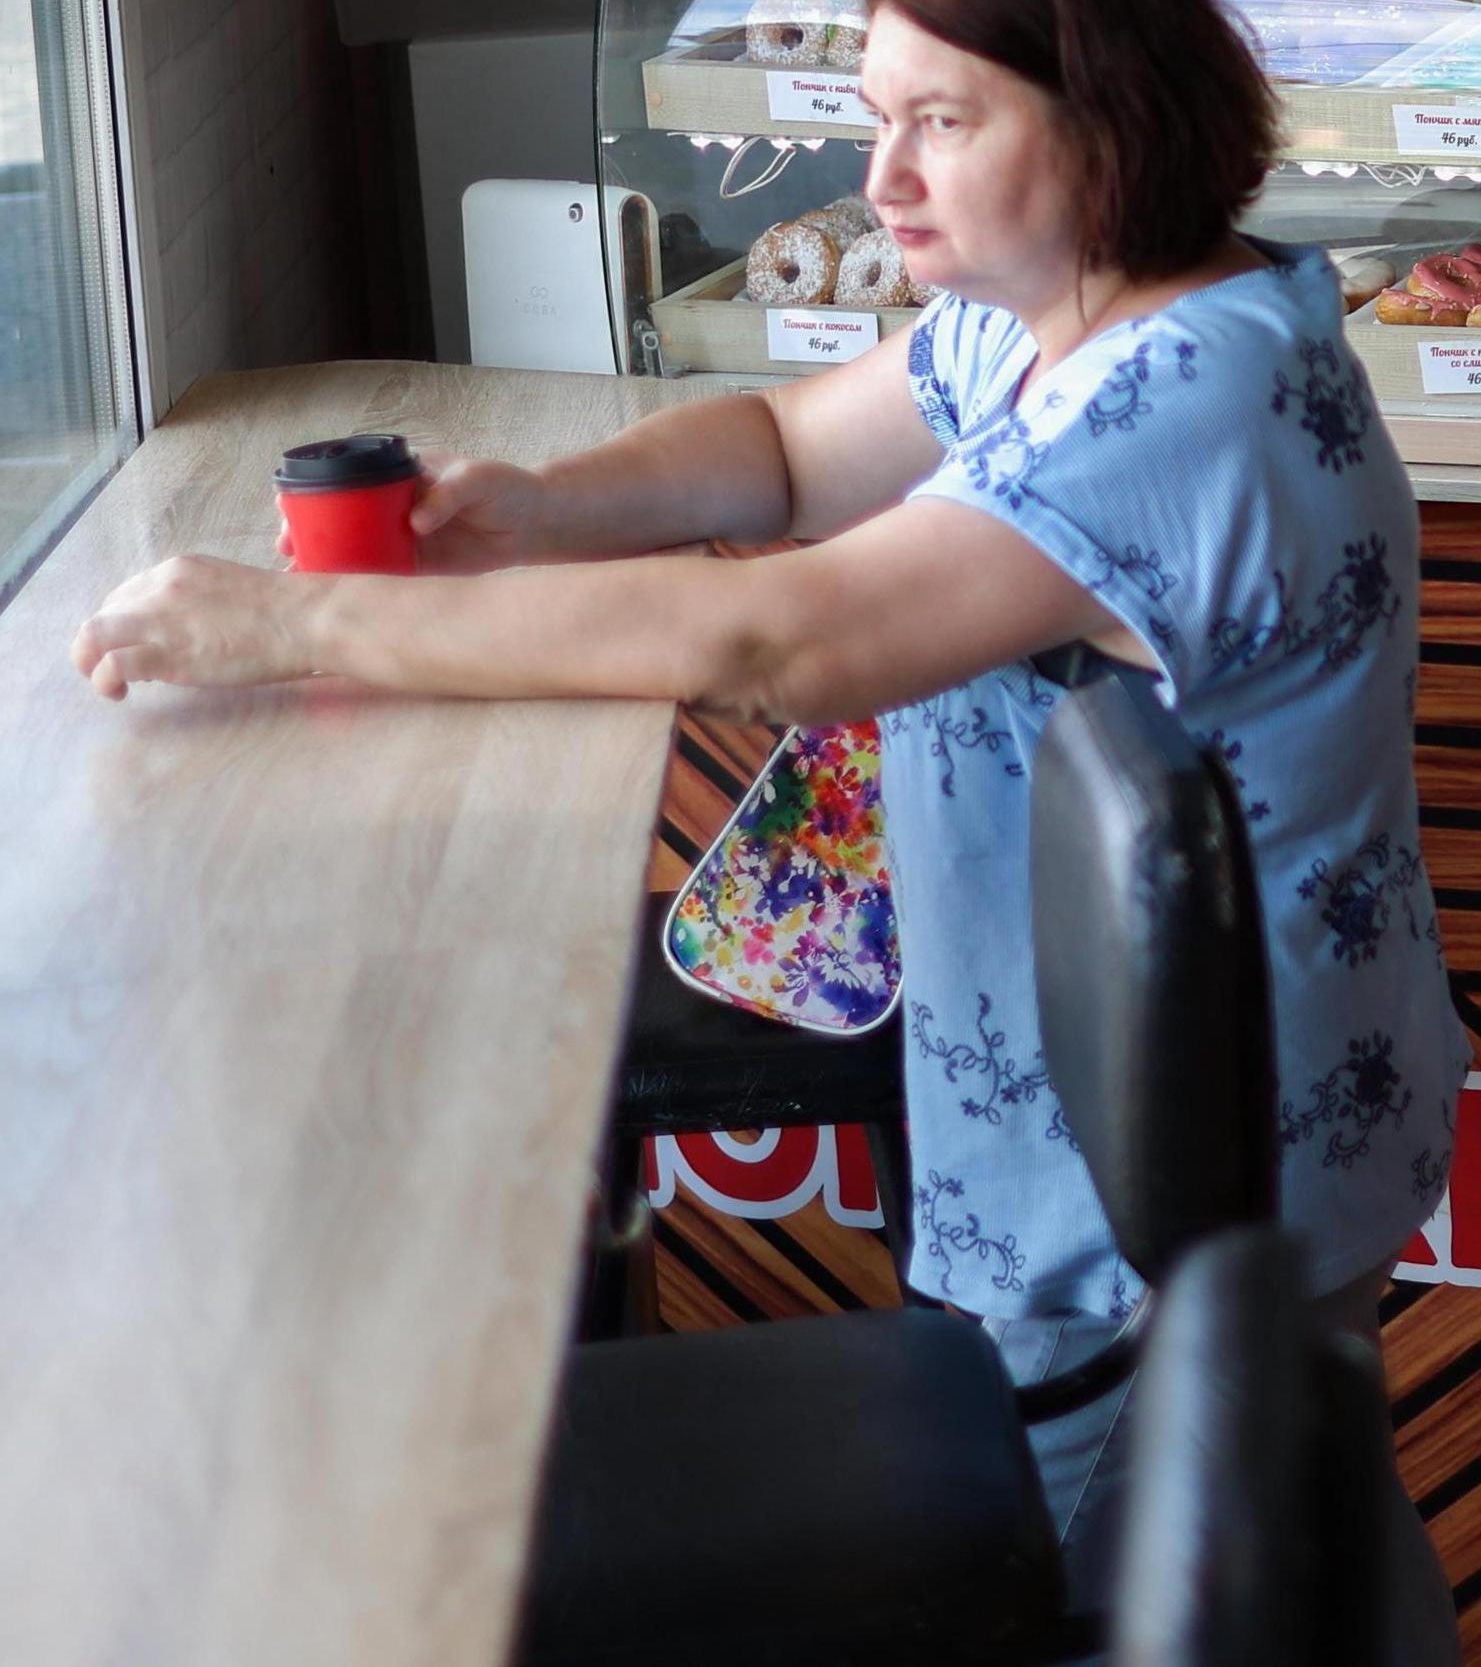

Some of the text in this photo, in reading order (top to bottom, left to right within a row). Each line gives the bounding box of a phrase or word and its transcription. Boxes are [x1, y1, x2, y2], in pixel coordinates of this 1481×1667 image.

[792, 80, 857, 95] Пончик с киви
[812, 98, 845, 113] 46 руб.
[1415, 114, 1453, 125] Пончик
[1441, 132, 1478, 148] 46 руб.
[783, 318, 862, 332] Пончик с кокосом
[808, 337, 841, 352] 46 руб.
[1430, 346, 1468, 358] Пончик
[1470, 349, 1476, 357] с
[1450, 359, 1461, 368] со
[1467, 372, 1481, 385] 46
